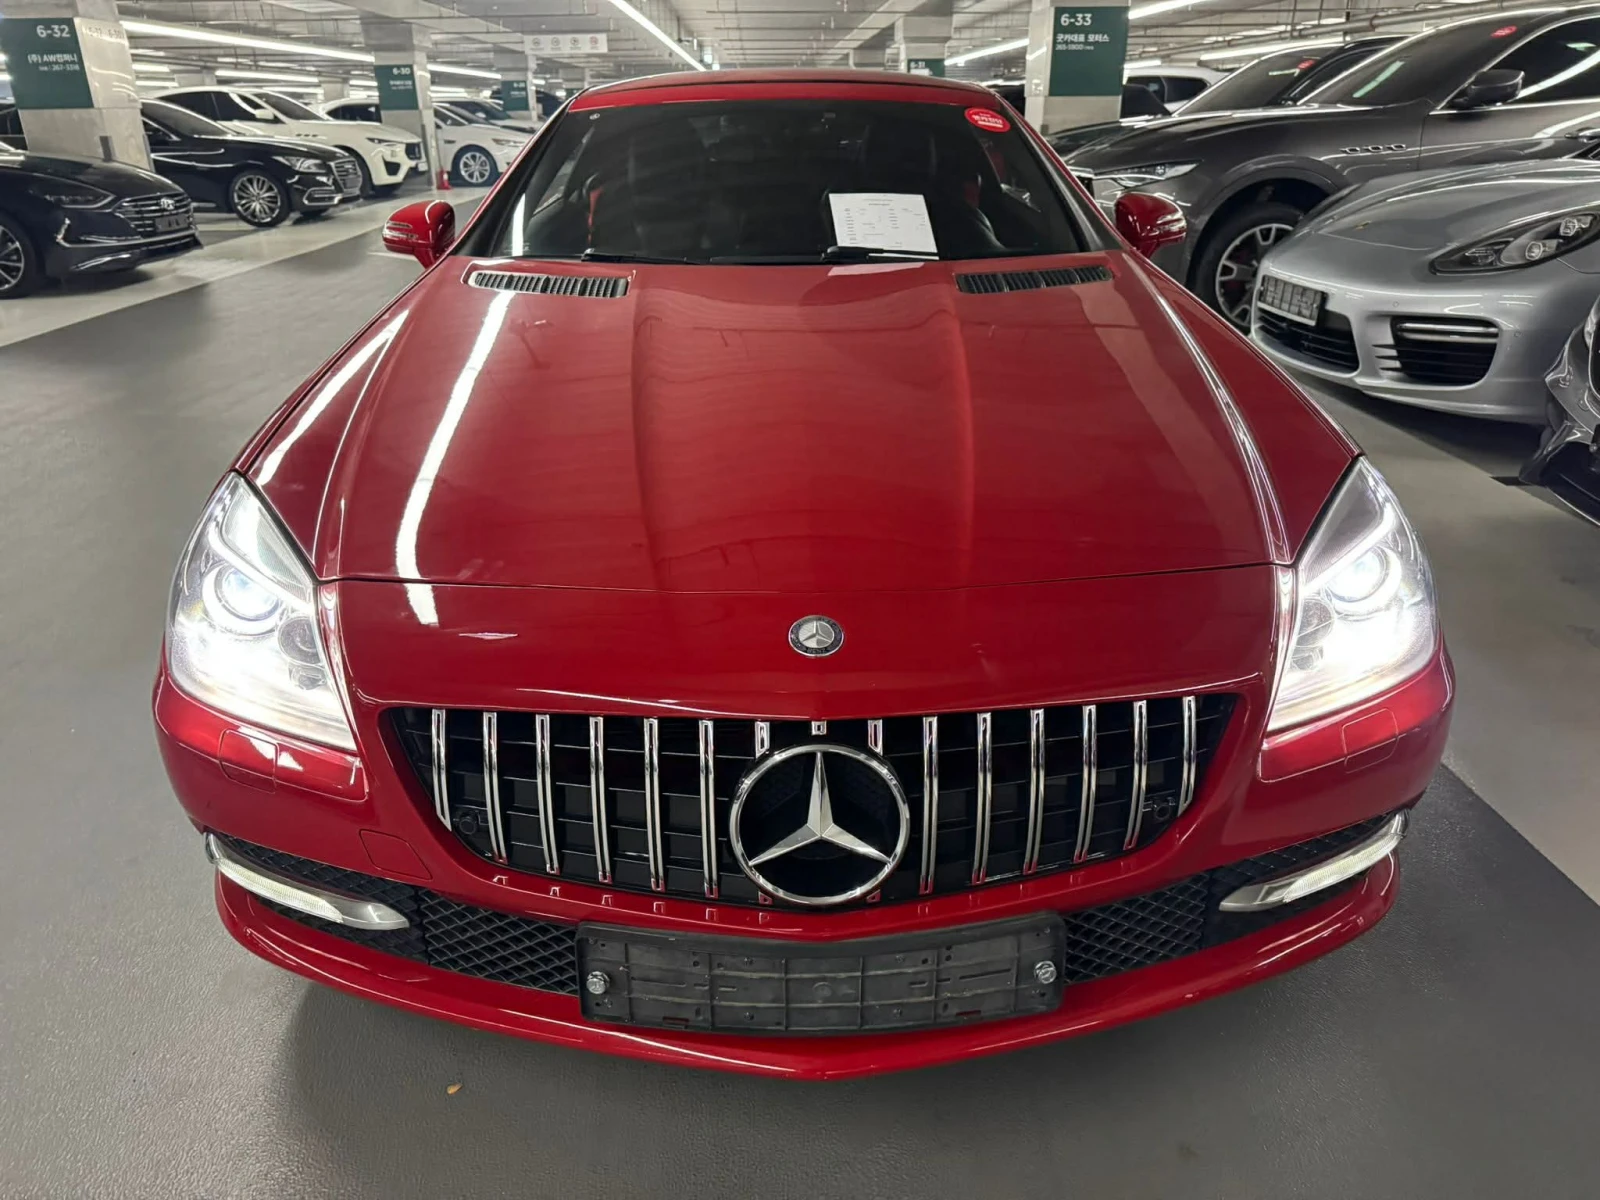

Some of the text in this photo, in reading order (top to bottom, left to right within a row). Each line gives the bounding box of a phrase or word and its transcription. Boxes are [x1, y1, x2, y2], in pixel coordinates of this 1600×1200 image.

[1060, 13, 1092, 26] 6-33
[36, 25, 70, 38] 6-32
[392, 66, 411, 76] 6-30
